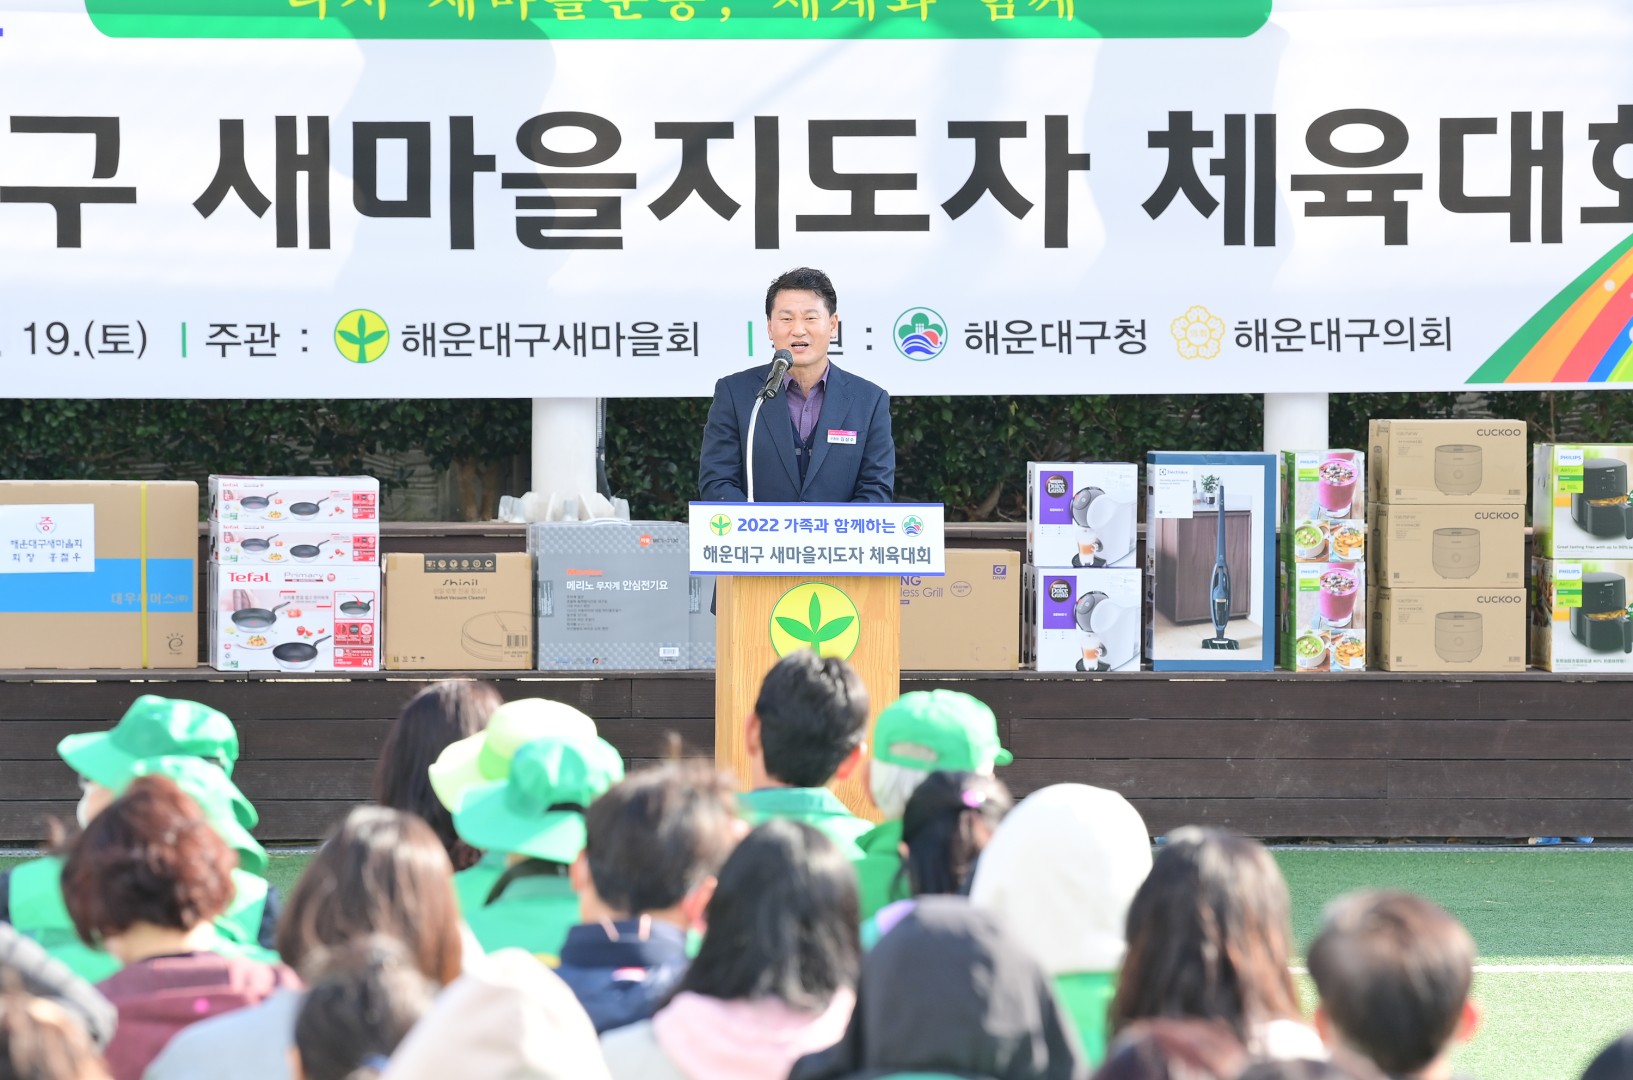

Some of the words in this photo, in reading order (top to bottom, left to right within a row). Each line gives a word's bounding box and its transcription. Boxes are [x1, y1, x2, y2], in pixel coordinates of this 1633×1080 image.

[0, 116, 137, 249] 구
[192, 111, 1091, 250] 새마을지도자
[205, 322, 281, 358] 주관
[401, 321, 699, 358] 해운대구새마을회
[963, 319, 1147, 356] 해운대구청
[1234, 316, 1452, 353] 해운대구의회
[1476, 428, 1521, 437] CUCKOO
[1474, 511, 1520, 520] CUCKOO
[737, 517, 780, 533] 2022
[783, 518, 830, 534] 가족과
[833, 517, 897, 534] 함께하는
[703, 544, 765, 564] 해운대구
[769, 545, 865, 565] 새마을지도자
[869, 545, 931, 565] 체육대회
[228, 572, 272, 583] Tefal
[284, 571, 324, 580] Primary
[566, 580, 595, 591] 메리노
[596, 581, 620, 591] 무자계
[622, 580, 669, 591] 안심전기요
[922, 587, 944, 598] Grill
[1476, 595, 1522, 604] CUCKOO
